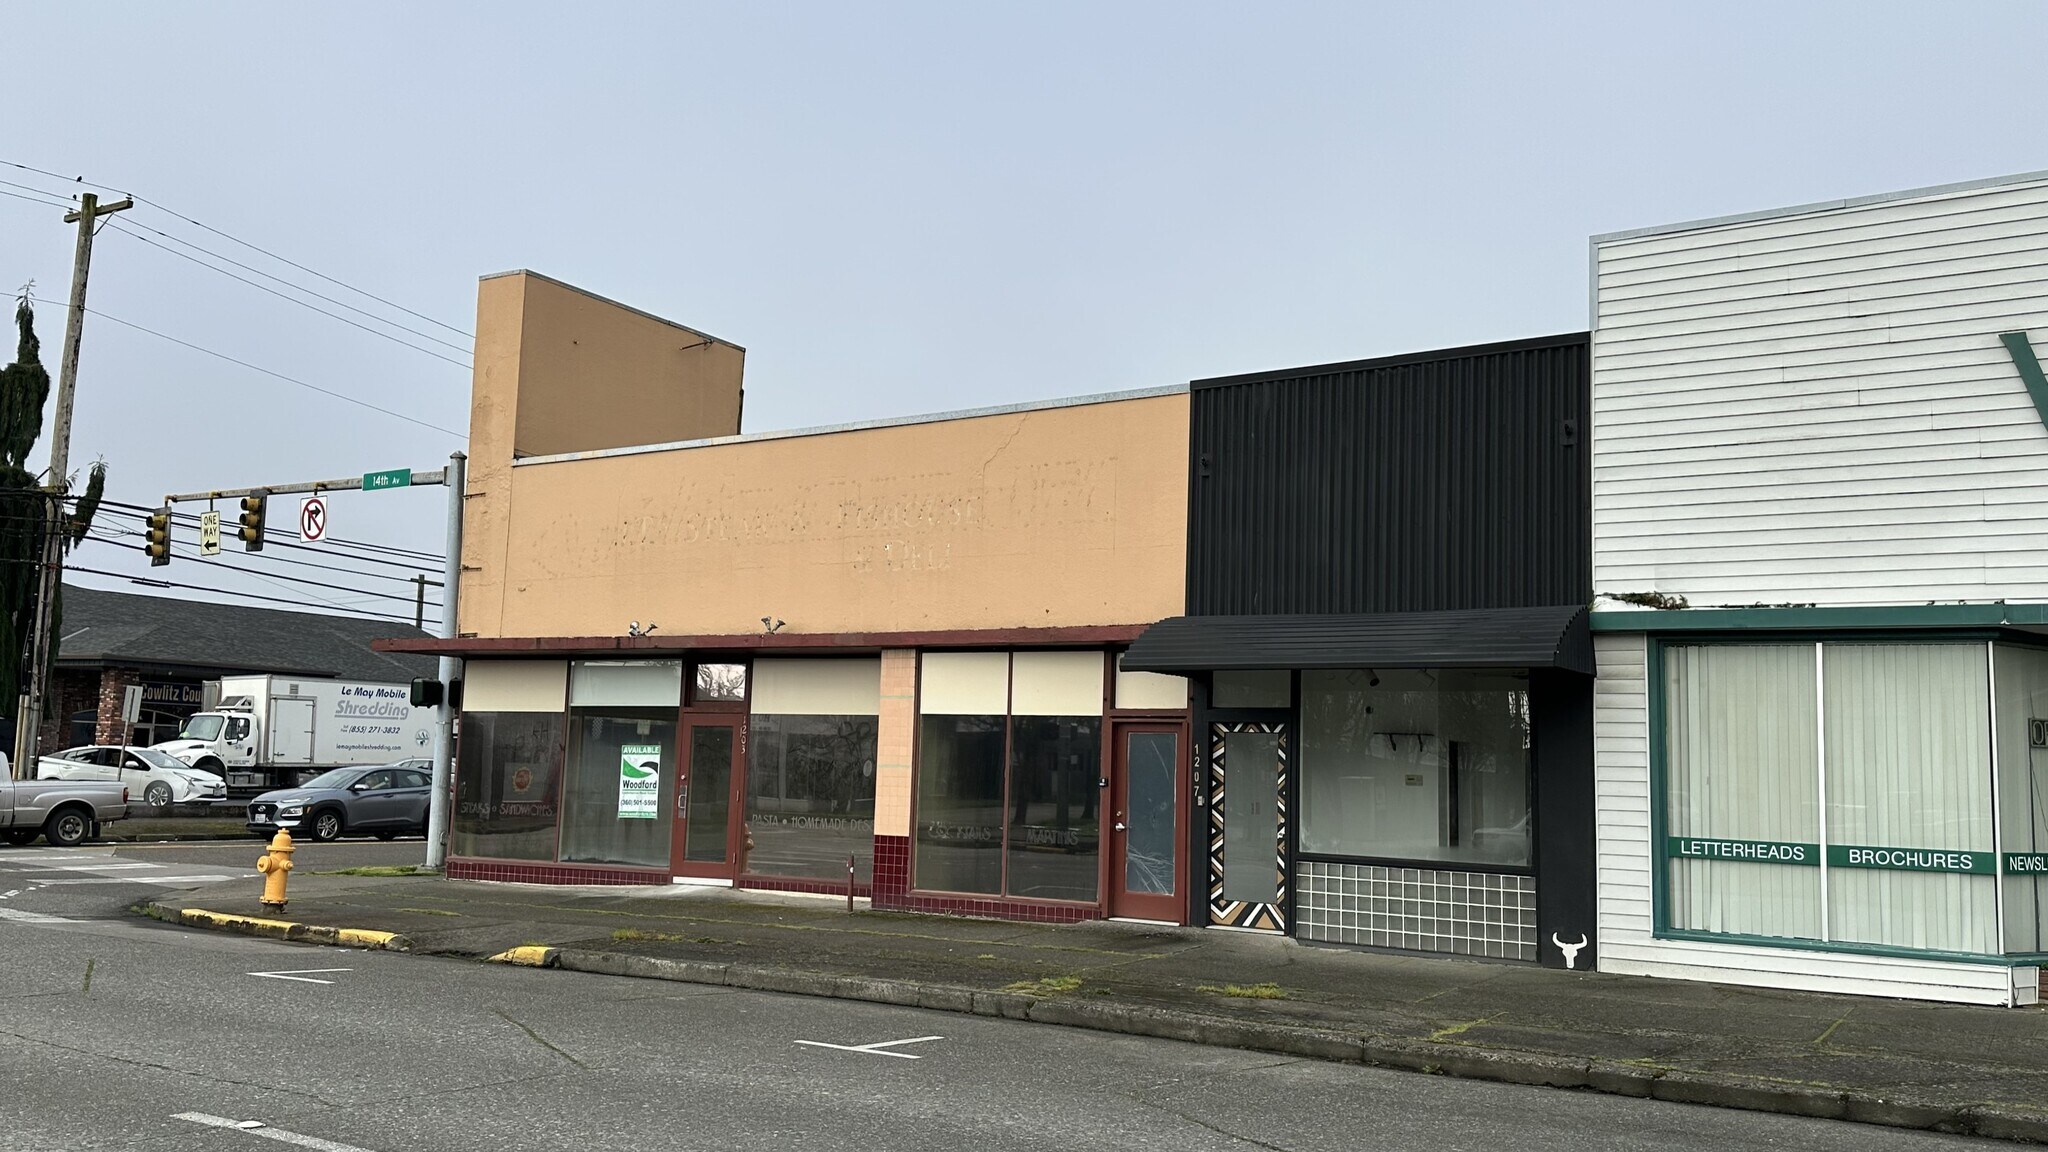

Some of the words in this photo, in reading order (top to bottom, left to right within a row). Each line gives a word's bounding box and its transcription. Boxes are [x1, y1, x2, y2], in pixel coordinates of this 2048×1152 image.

[372, 474, 389, 487] 14th
[391, 476, 400, 485] Av
[204, 515, 216, 525] ONE
[204, 527, 217, 536] WAY
[141, 683, 179, 702] Cowlitz
[182, 686, 203, 703] Cou
[341, 686, 352, 695] Le
[354, 687, 374, 699] May
[376, 689, 406, 698] Mobile
[335, 700, 409, 720] Shredding
[349, 725, 367, 734] (855)
[369, 725, 401, 734] 271-3832
[623, 780, 657, 788] Woodford
[752, 814, 779, 827] PASTA
[791, 816, 846, 831] HOMEMADE
[850, 818, 873, 831] DES
[1680, 840, 1805, 861] LETTERHEADS
[1848, 849, 1973, 870] BROCHURES
[2009, 855, 2048, 872] NEWSL
